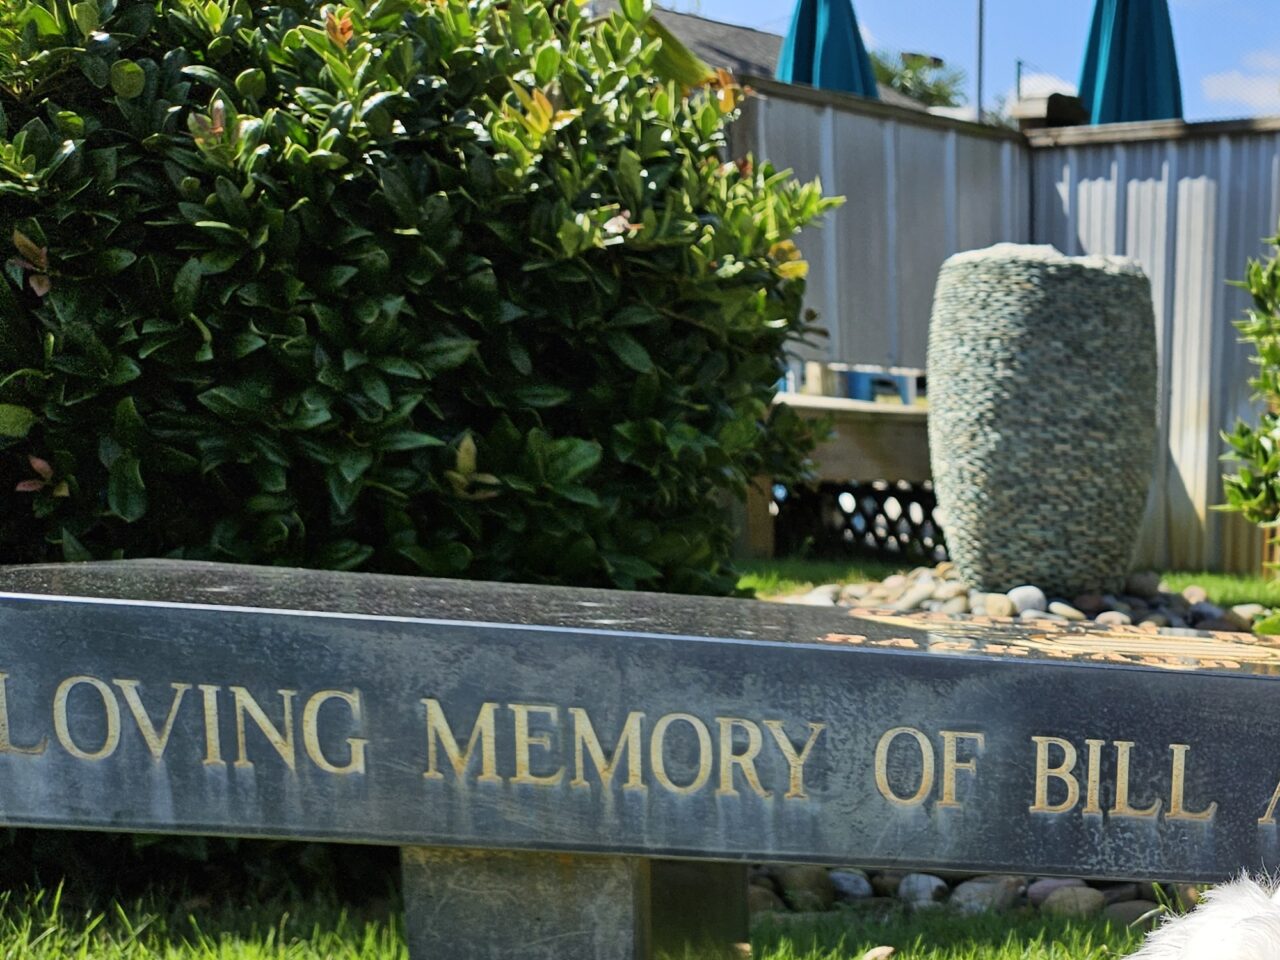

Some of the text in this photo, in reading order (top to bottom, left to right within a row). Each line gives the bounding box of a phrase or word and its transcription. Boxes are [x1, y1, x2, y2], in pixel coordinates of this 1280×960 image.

[0, 672, 370, 776] LOVING
[421, 697, 826, 800] MEMORY
[874, 726, 985, 808] OF
[1029, 734, 1218, 822] BILL
